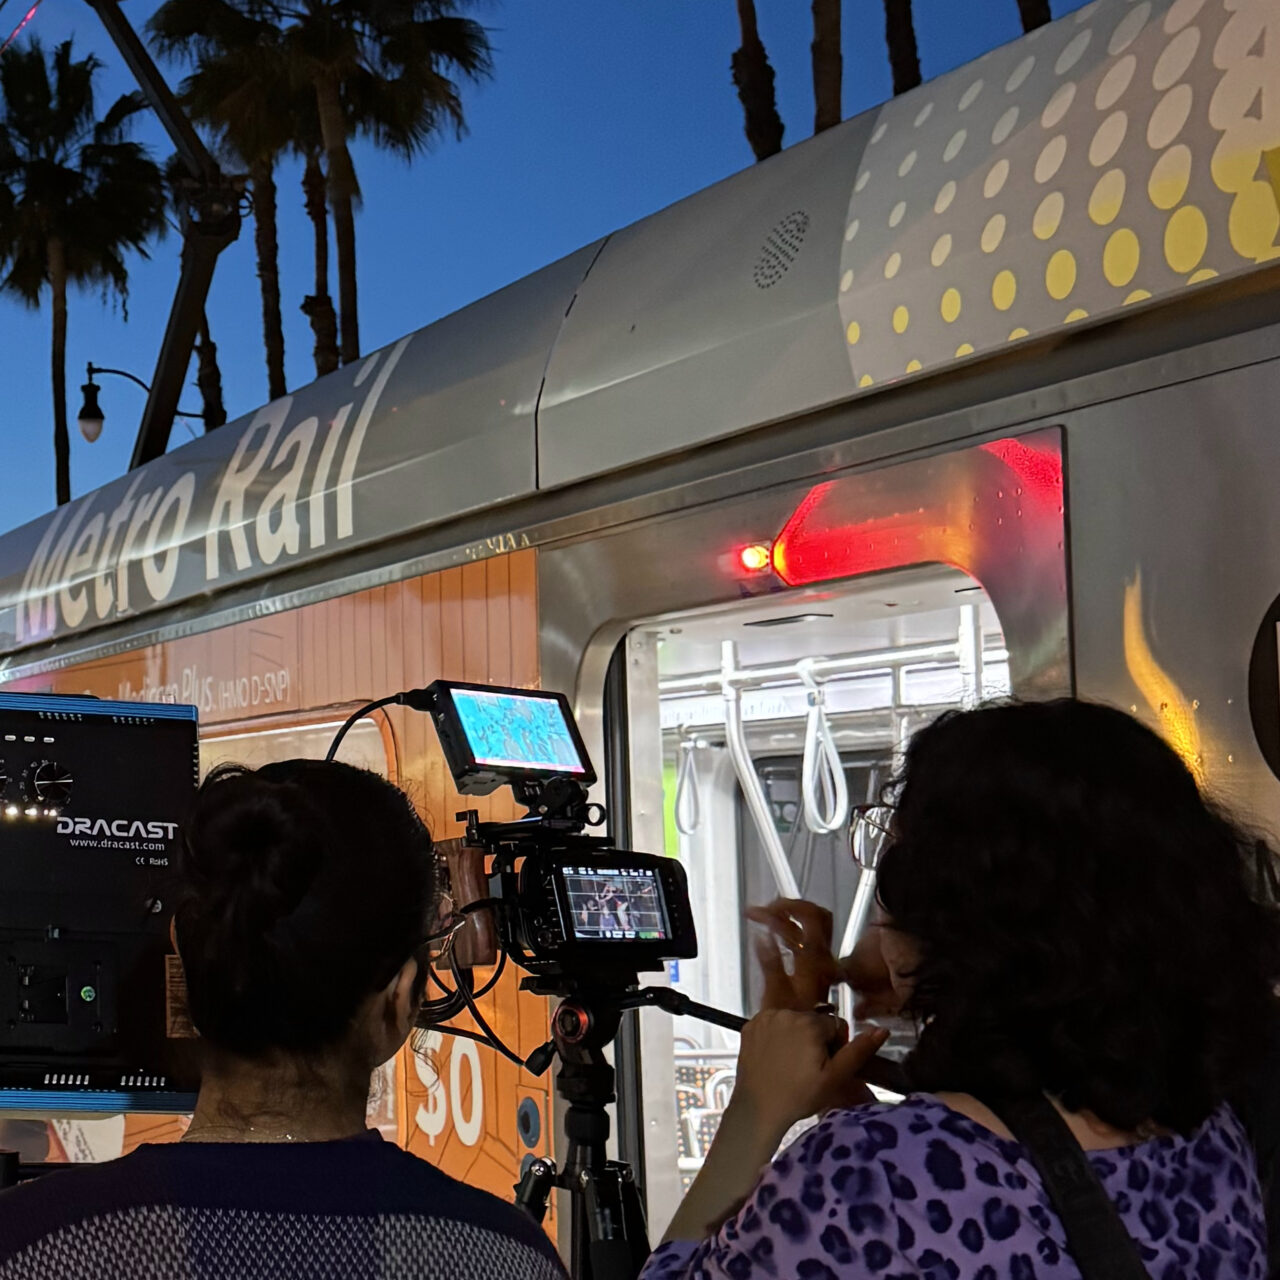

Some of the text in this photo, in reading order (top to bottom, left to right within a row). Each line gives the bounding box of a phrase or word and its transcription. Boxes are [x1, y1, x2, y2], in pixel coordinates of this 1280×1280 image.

[16, 335, 412, 643] Metro Rail
[219, 678, 249, 711] (HMO
[251, 668, 290, 706] D-SNP)
[56, 816, 179, 840] DRACAST
[70, 838, 165, 851] www.dracast.com
[410, 1029, 483, 1147] $0
